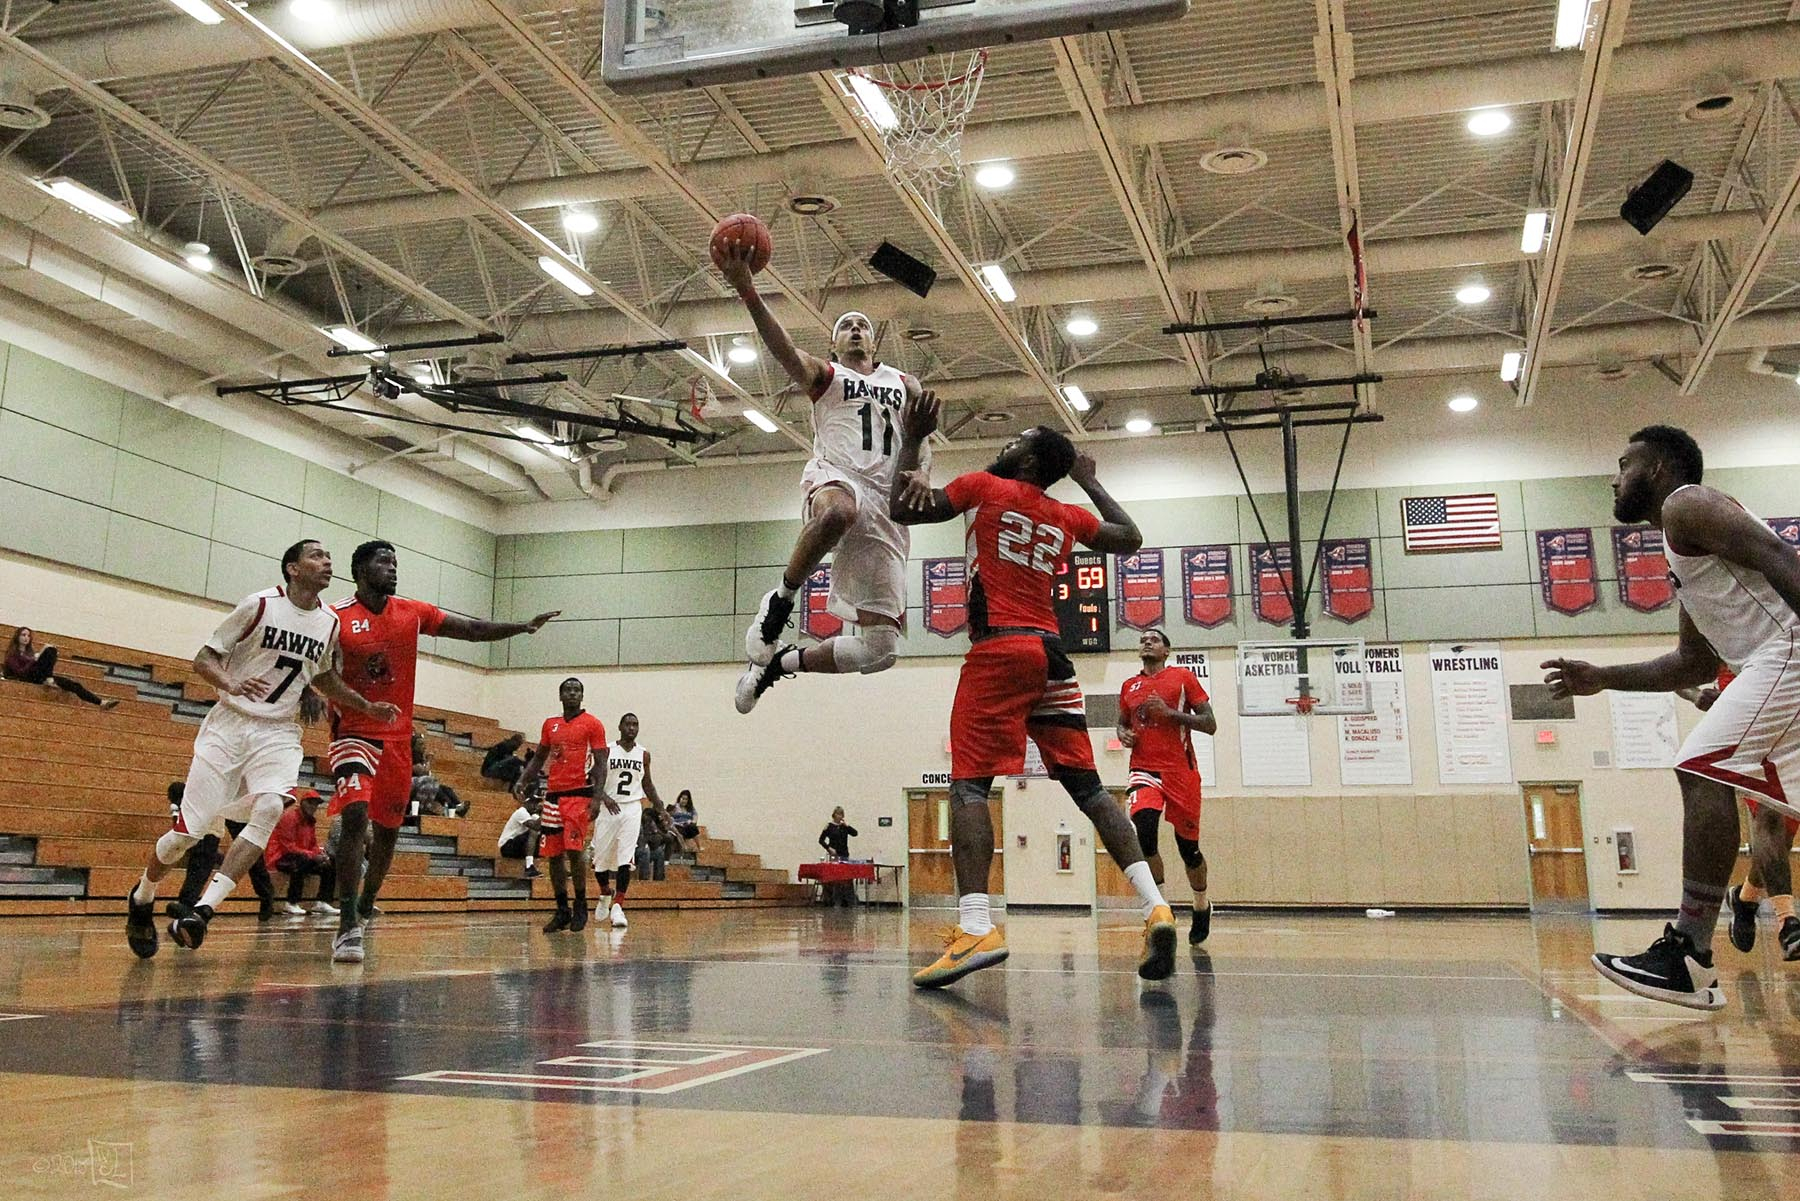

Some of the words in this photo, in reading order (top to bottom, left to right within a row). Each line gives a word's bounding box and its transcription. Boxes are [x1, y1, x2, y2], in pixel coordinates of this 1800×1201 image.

[843, 378, 903, 411] HAWKS
[857, 402, 894, 456] 11
[998, 511, 1065, 576] 22
[1078, 567, 1104, 590] 69
[351, 618, 370, 634] 24
[1091, 617, 1098, 632] 1
[260, 625, 325, 663] HAWKS
[1364, 648, 1399, 659] OMENS
[1176, 654, 1205, 664] MENS
[1262, 651, 1298, 662] WOMEN
[1432, 656, 1498, 672] WRESTLING
[264, 654, 304, 704] 7
[609, 757, 643, 773] HAWKS
[336, 772, 362, 798] 24
[616, 771, 634, 797] 2
